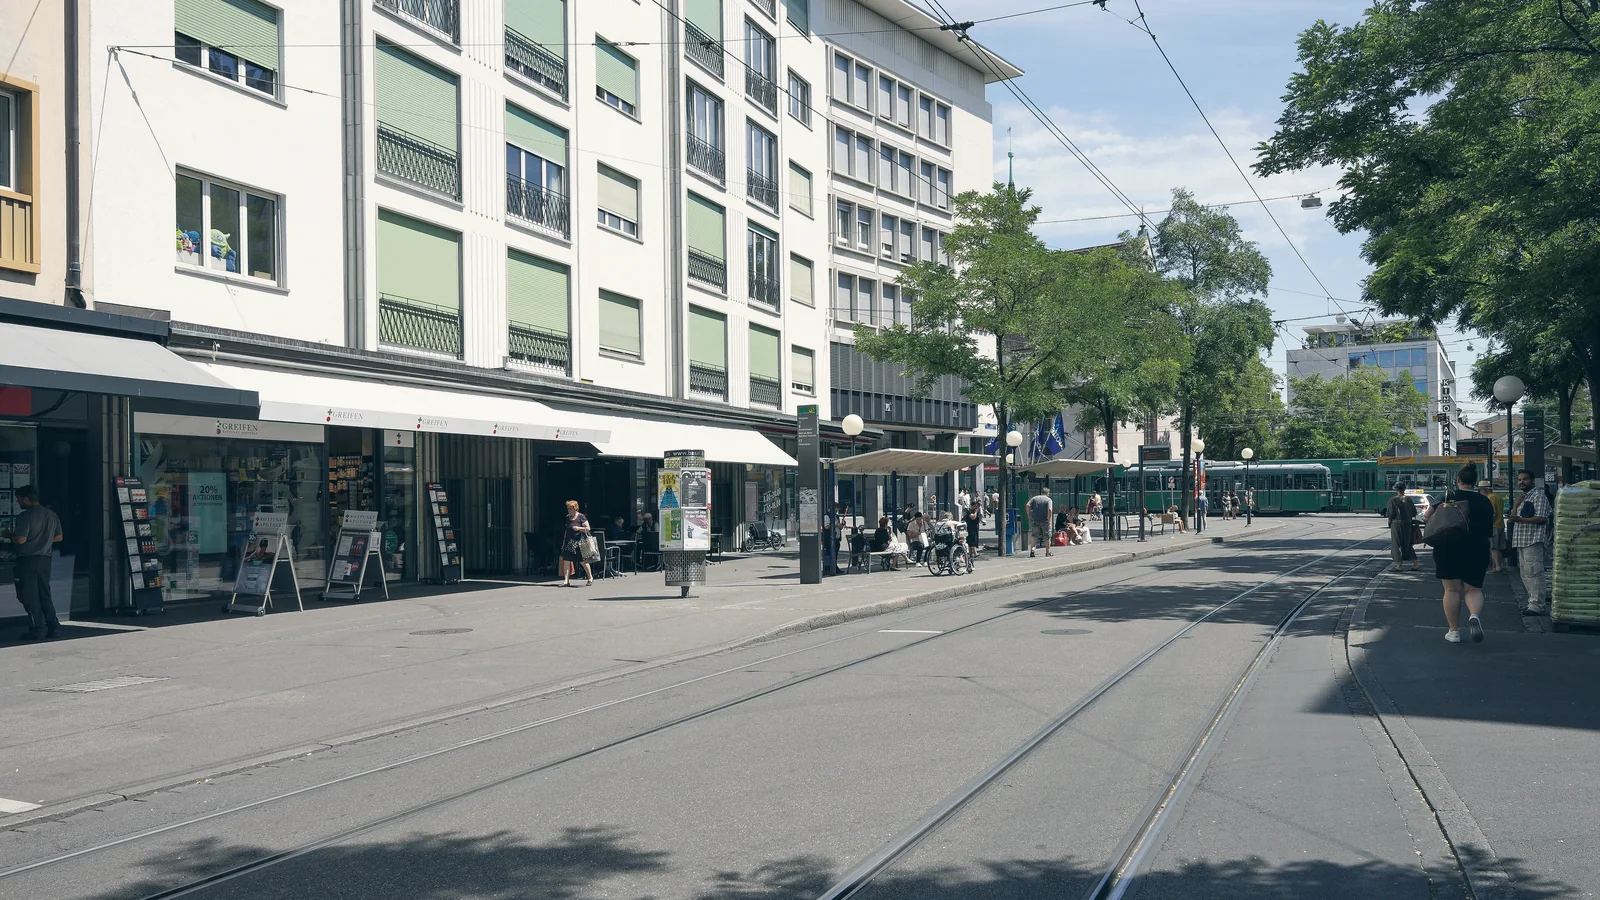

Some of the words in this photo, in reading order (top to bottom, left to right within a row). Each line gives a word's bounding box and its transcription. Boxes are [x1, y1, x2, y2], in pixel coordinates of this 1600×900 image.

[1442, 379, 1450, 412] KINO
[332, 411, 364, 420] GREIFEN
[222, 422, 258, 431] GREIFEN
[422, 419, 448, 427] GREIFEN
[200, 485, 218, 494] 20%
